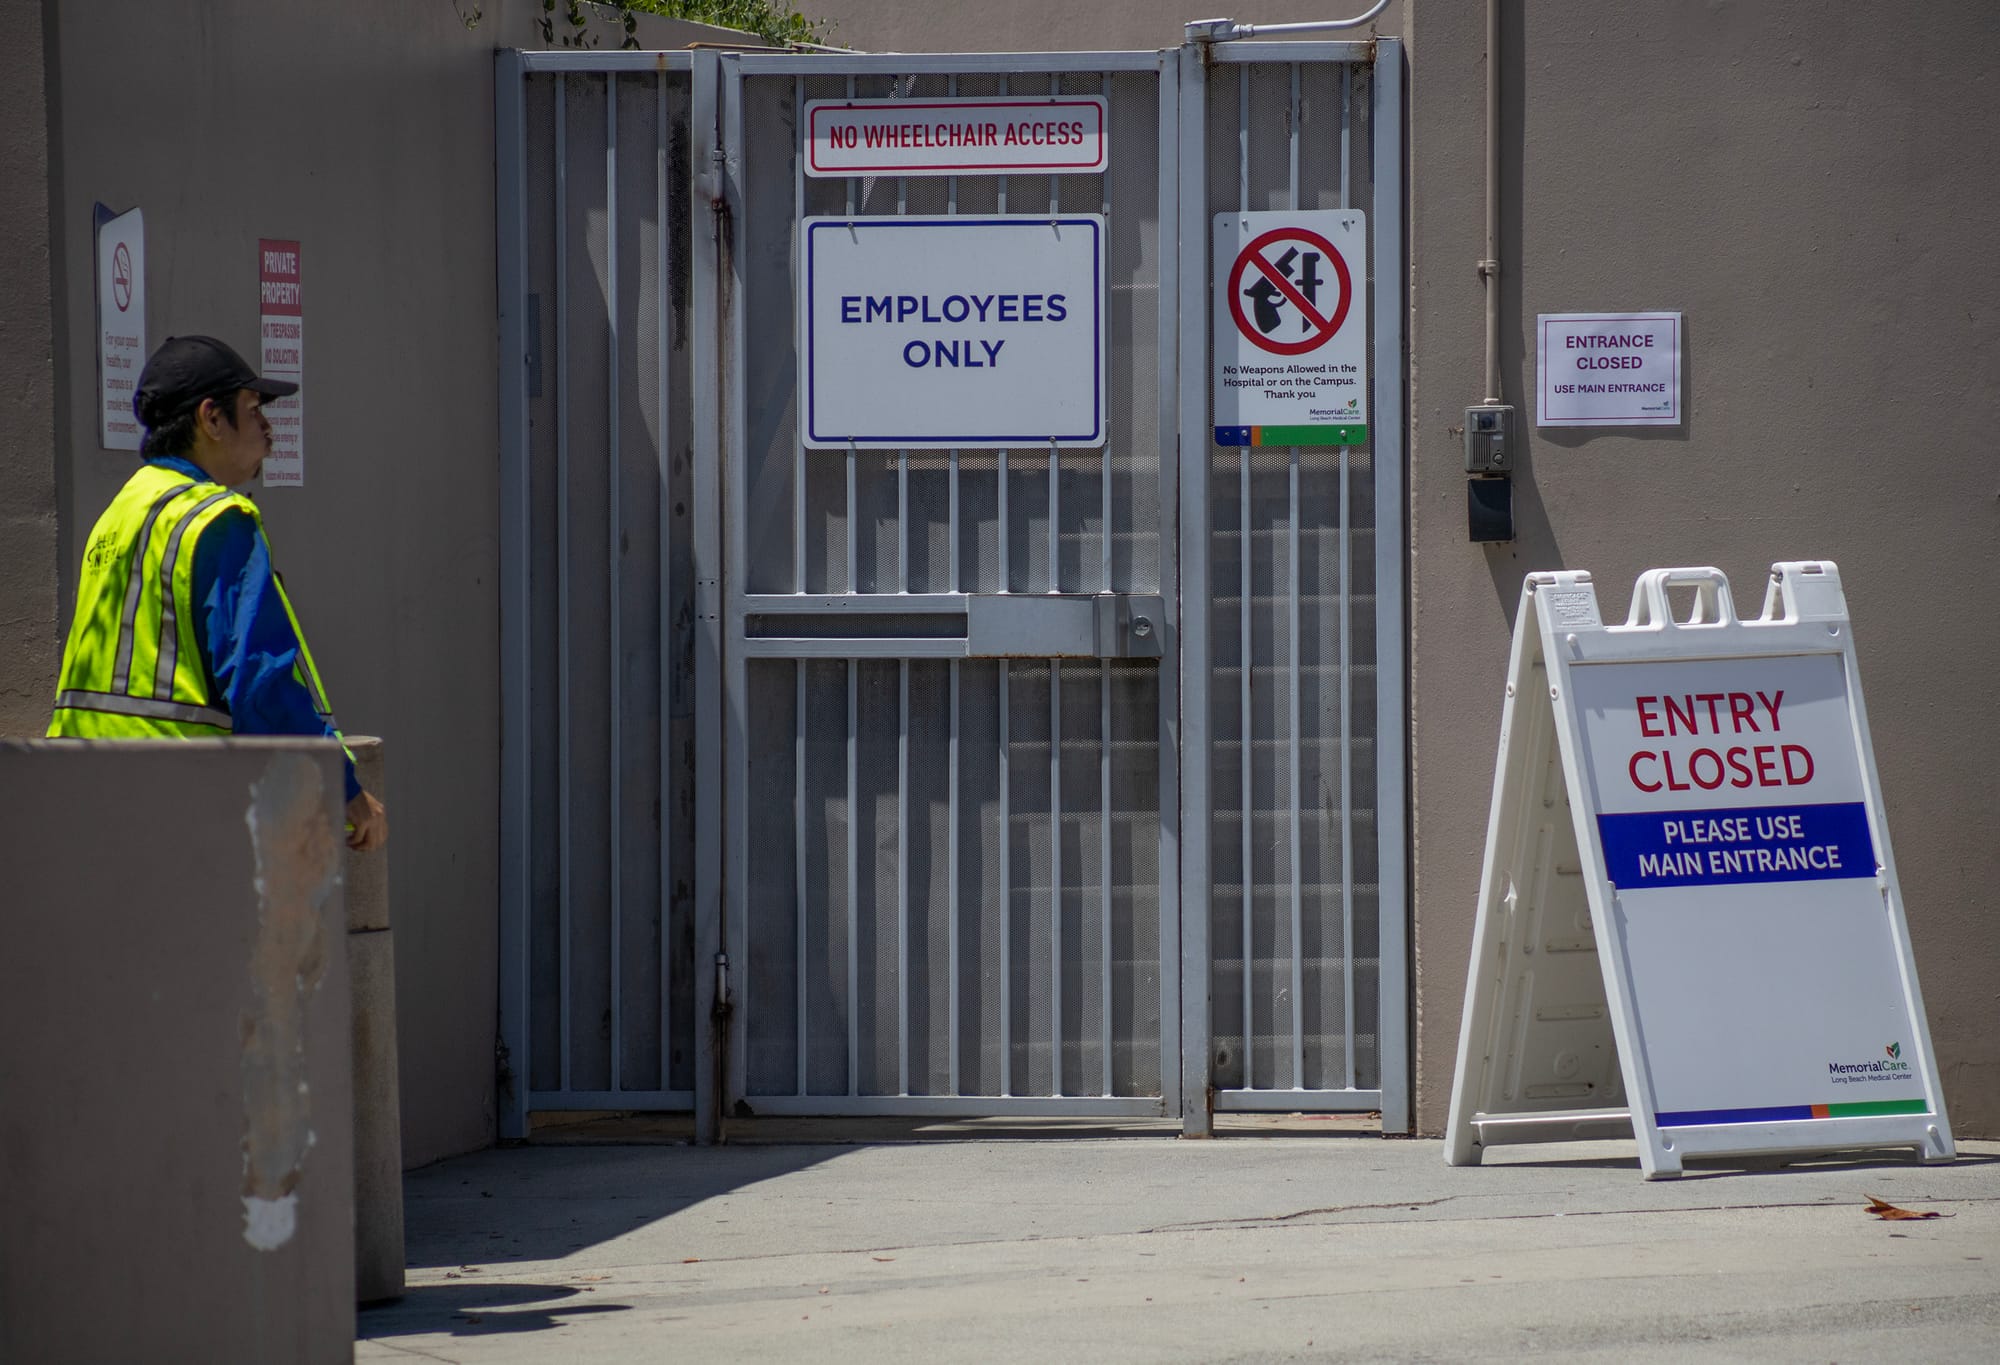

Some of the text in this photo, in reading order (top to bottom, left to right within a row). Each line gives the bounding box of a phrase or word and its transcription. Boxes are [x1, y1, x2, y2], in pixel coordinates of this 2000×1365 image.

[830, 121, 1084, 149] NO WHEELCHAIR ACCESS
[264, 250, 296, 274] PRIVATE
[261, 281, 300, 305] PROPERTY
[841, 294, 1067, 323] EMPLOYEES
[903, 340, 1005, 368] ONLY
[1566, 335, 1654, 349] ENTRANCE
[1223, 363, 1357, 375] No Weapons Allowed in the
[1576, 356, 1643, 370] CLOSED
[1224, 376, 1357, 388] Hospital or on the Campus.
[1554, 383, 1665, 394] USE MAIN ENTRANCE
[1264, 390, 1316, 400] Thank you
[1636, 690, 1784, 737] ENTRY
[1629, 744, 1814, 793] CLOSED
[1663, 815, 1805, 845] PLEASE USE
[1638, 845, 1842, 878] MAIN ENTRANCE
[1829, 1060, 1909, 1074] MemorialCare
[1831, 1073, 1912, 1084] Long Beach Medical Center
